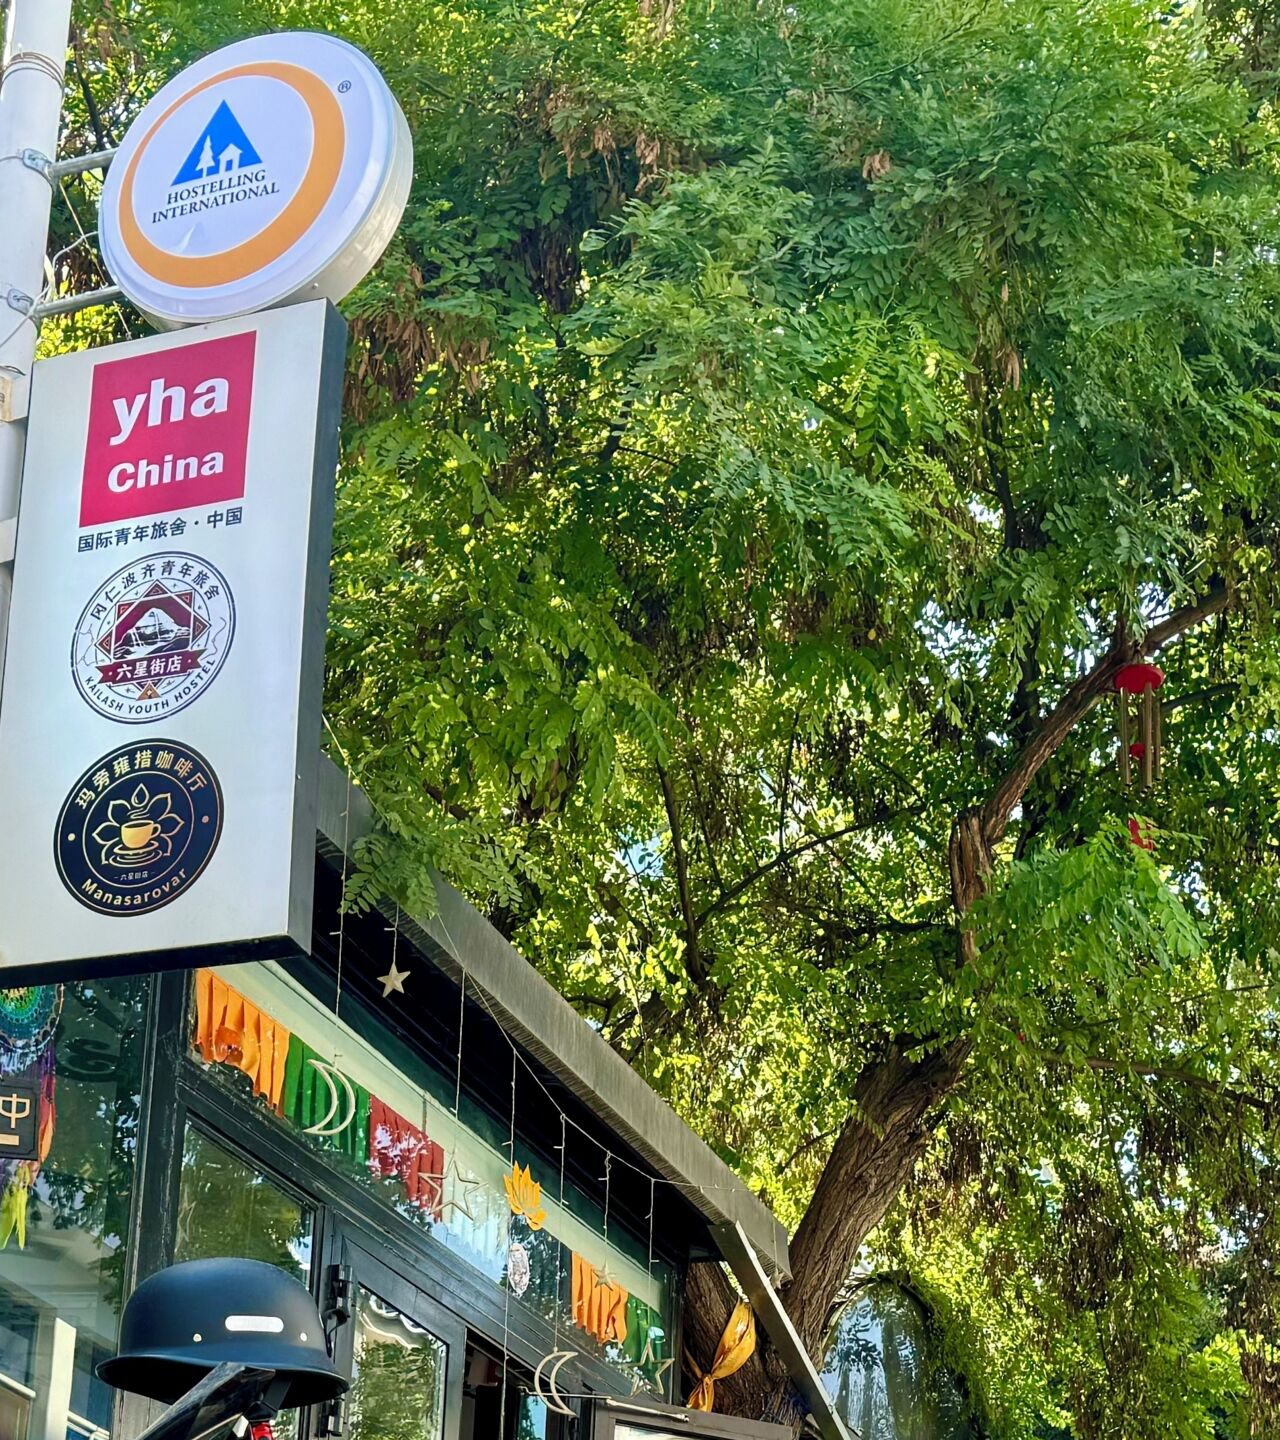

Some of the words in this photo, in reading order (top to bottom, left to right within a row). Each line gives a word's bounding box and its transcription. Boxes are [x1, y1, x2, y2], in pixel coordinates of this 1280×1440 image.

[152, 182, 280, 223] INTERNATIONAL
[166, 169, 267, 205] HOSTELLING
[109, 377, 229, 446] yha
[107, 451, 224, 493] China
[90, 560, 220, 621] 冈仁波齐青年旅舍
[85, 676, 125, 712] KAILASH
[128, 700, 170, 715] YOUTH
[174, 659, 216, 703] HOSTEL
[116, 655, 183, 681] 六星街店
[74, 750, 208, 810] 玛旁雍措咖啡厅
[81, 868, 190, 906] Manasarovar
